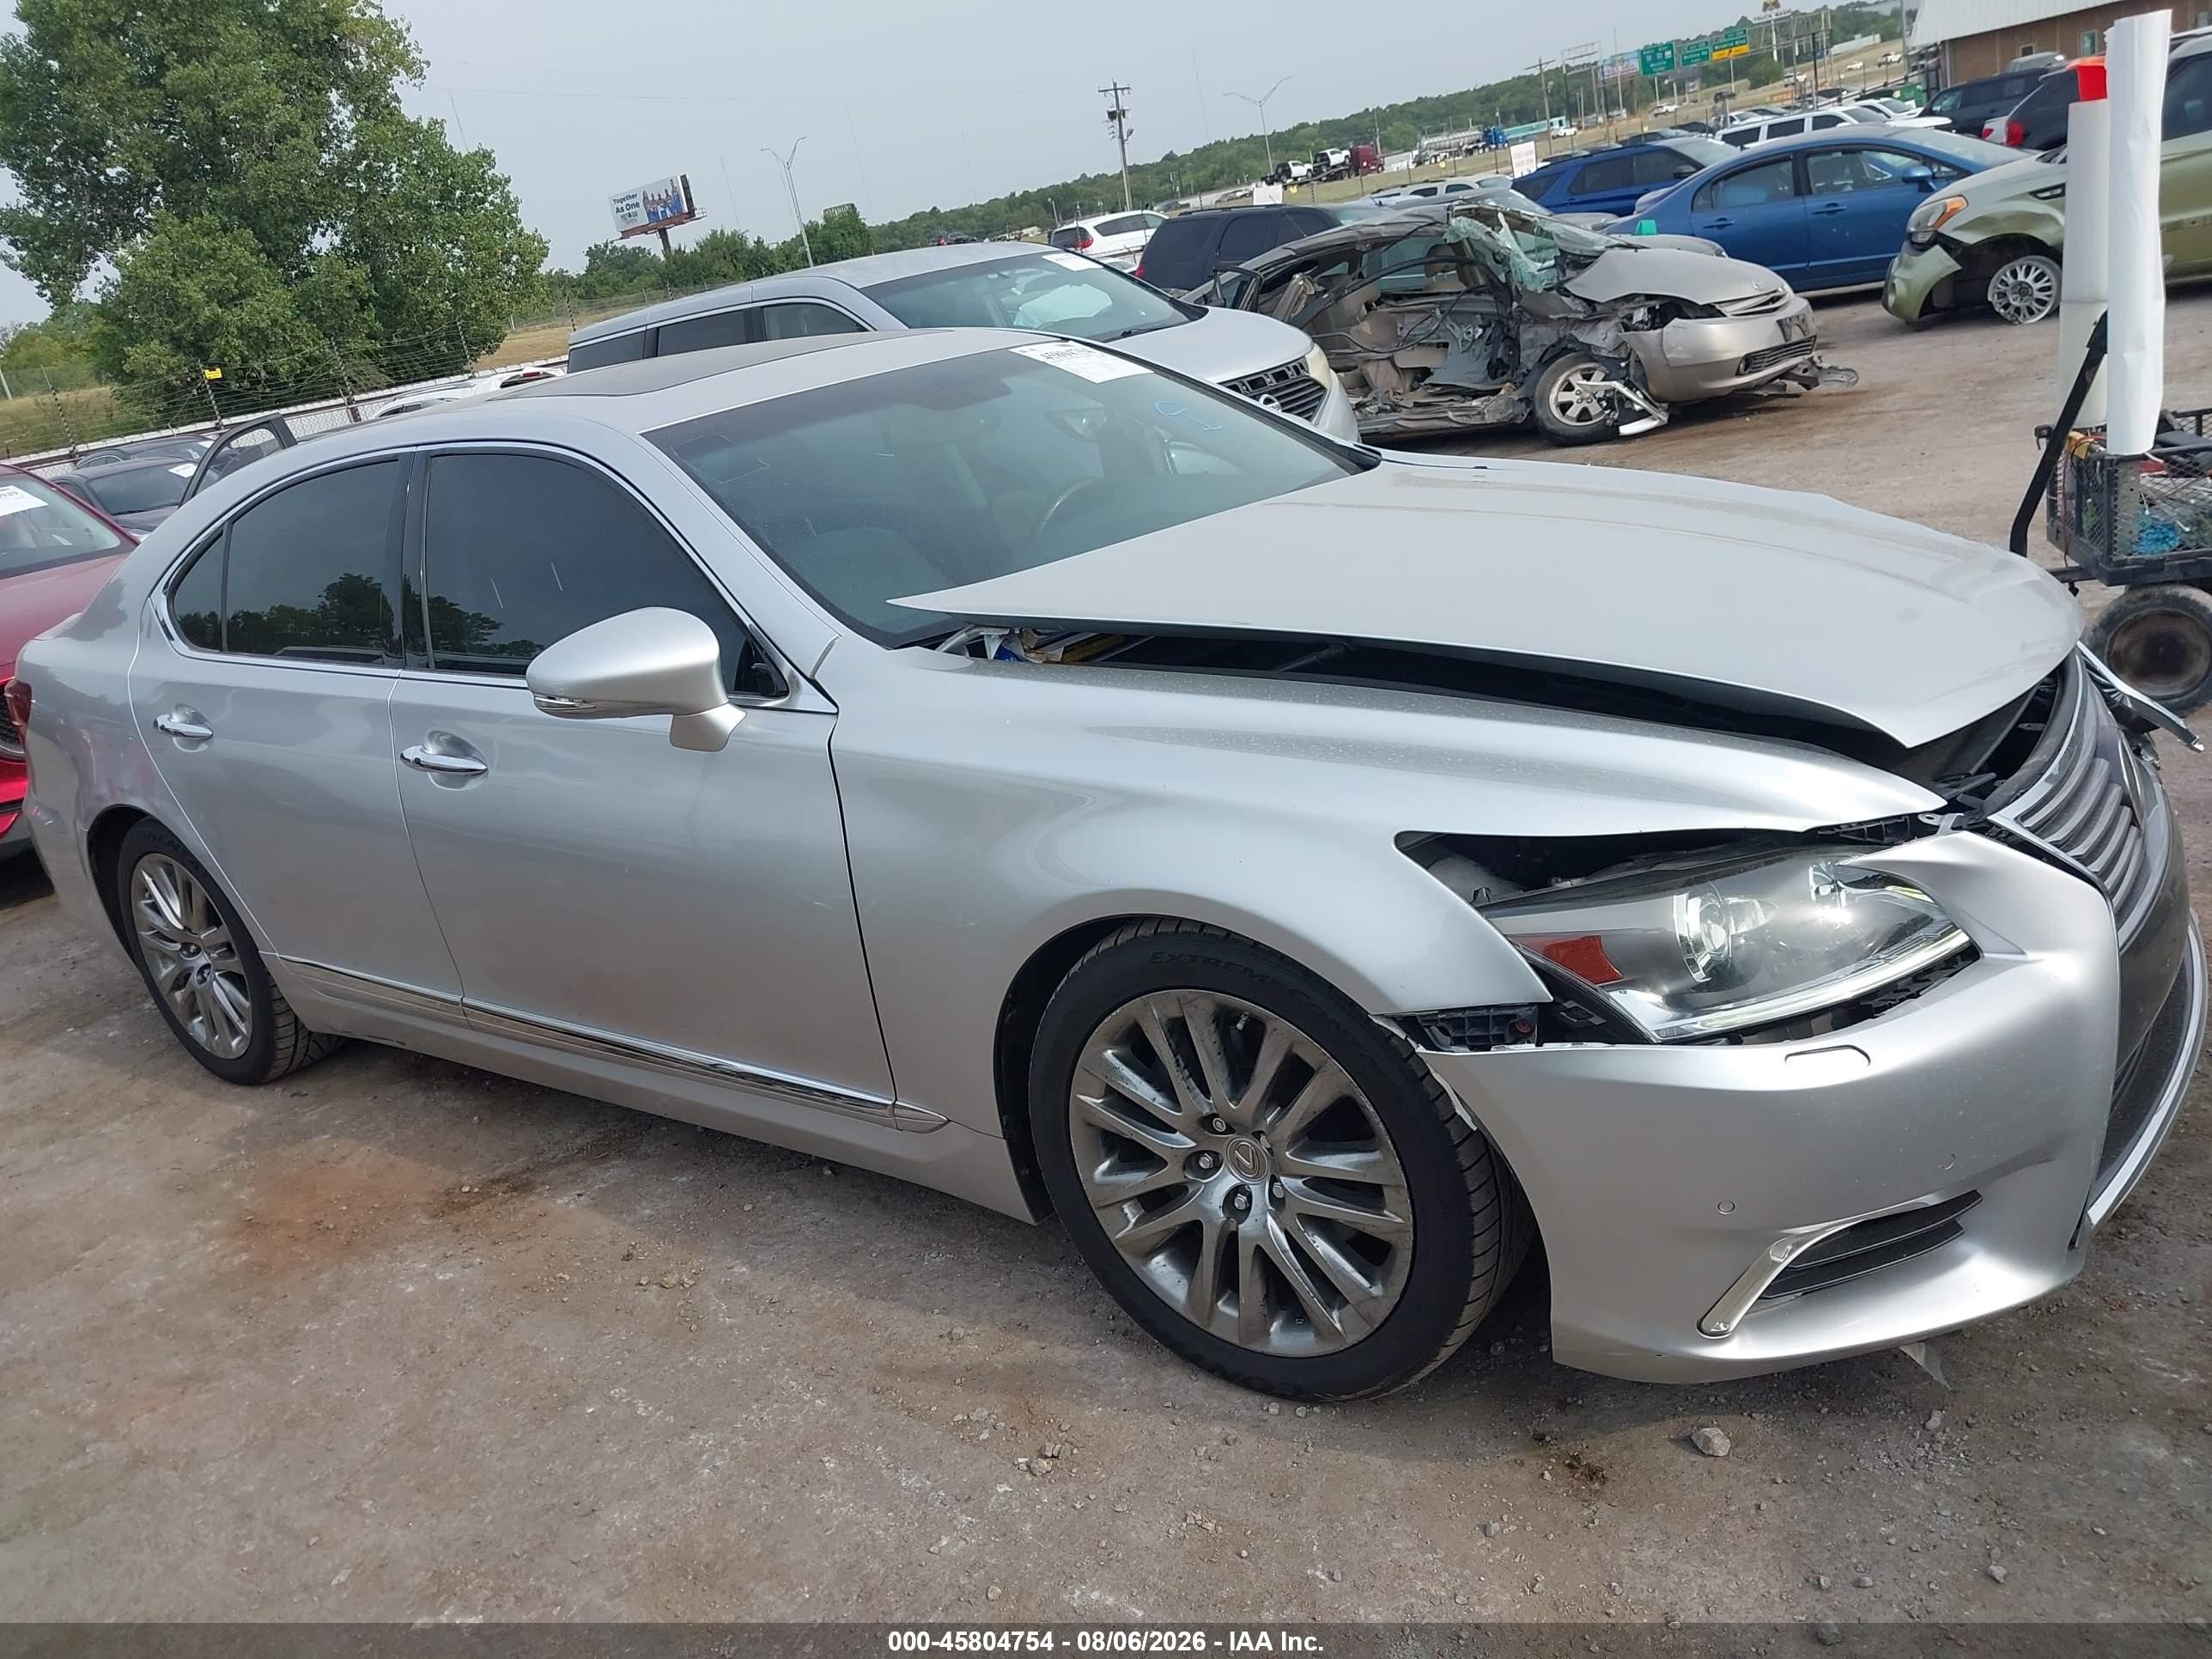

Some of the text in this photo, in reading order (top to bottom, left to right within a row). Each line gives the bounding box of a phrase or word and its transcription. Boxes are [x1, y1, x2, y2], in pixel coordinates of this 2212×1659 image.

[612, 193, 637, 204] Together
[615, 202, 641, 214] As One
